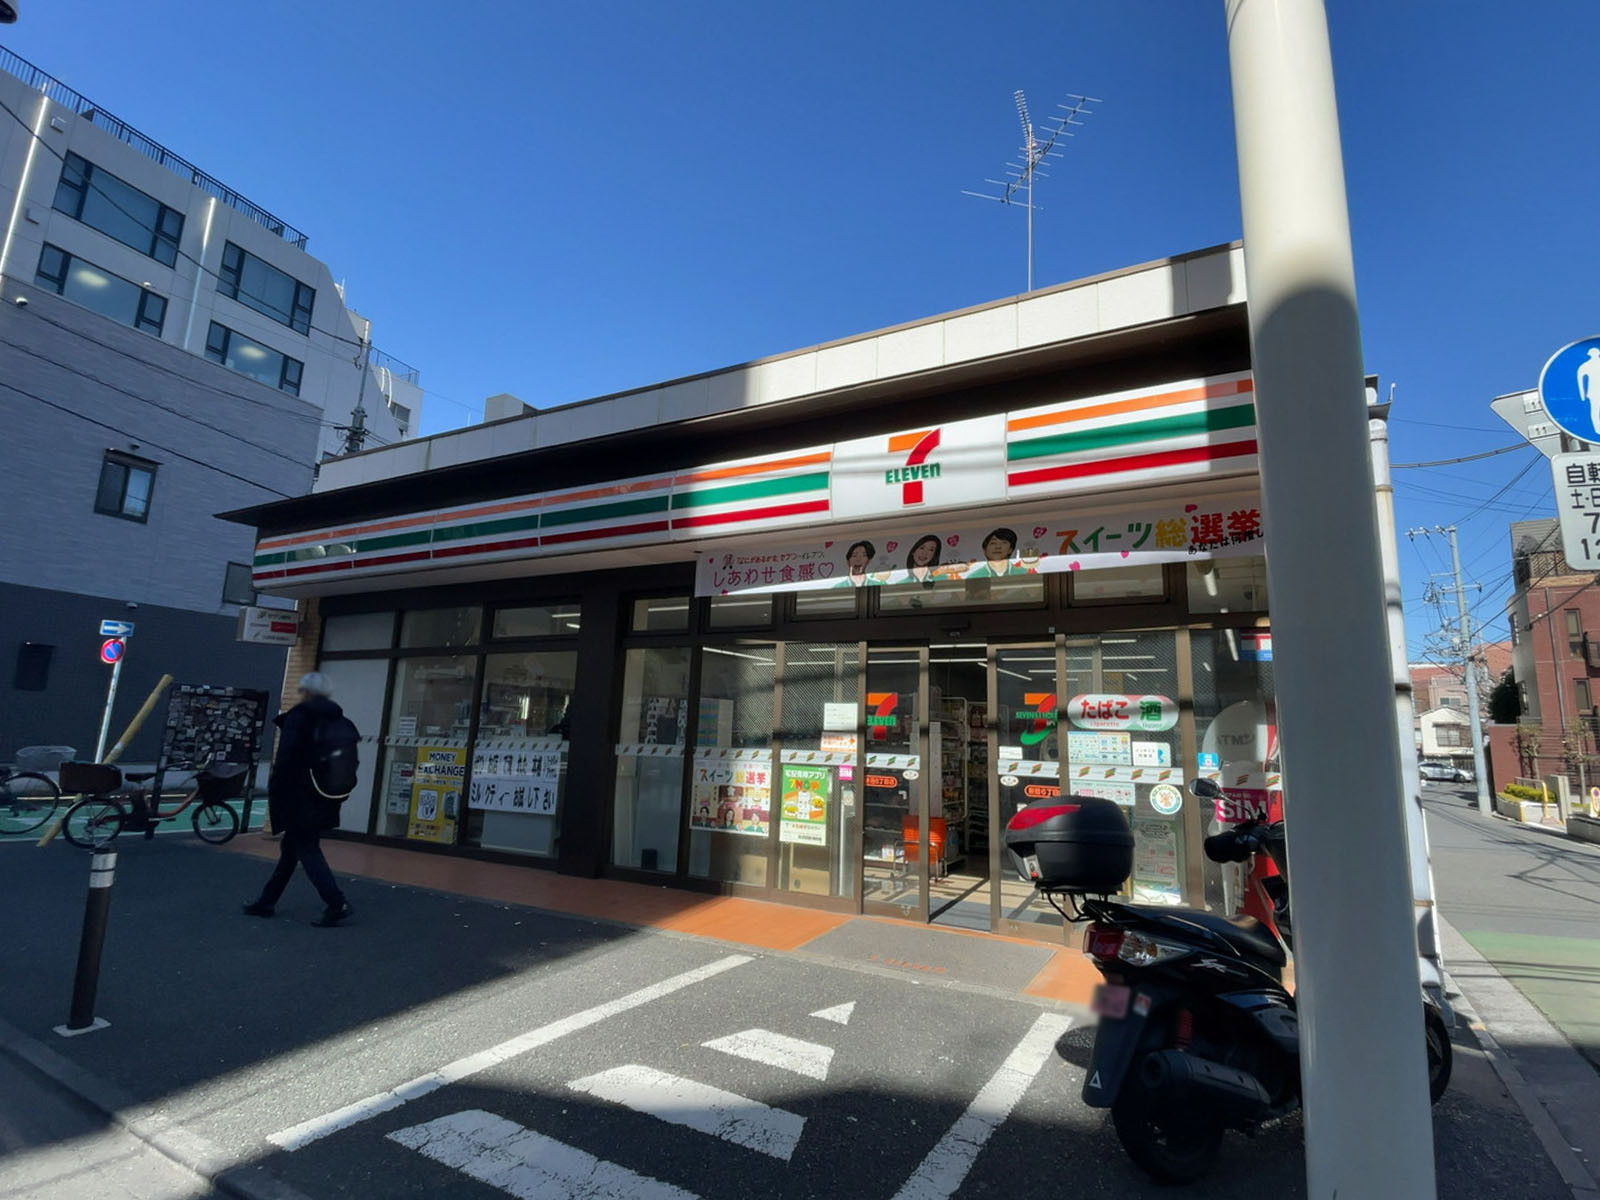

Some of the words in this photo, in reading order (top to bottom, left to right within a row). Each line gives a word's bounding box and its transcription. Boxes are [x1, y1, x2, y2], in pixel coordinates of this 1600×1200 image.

[1056, 508, 1260, 555] スイーツ総選挙
[1081, 699, 1129, 719] たばこ
[1140, 700, 1162, 721] 酒
[429, 752, 457, 761] MONEY
[418, 764, 465, 777] EXCHANGE
[1219, 800, 1267, 821] SIM
